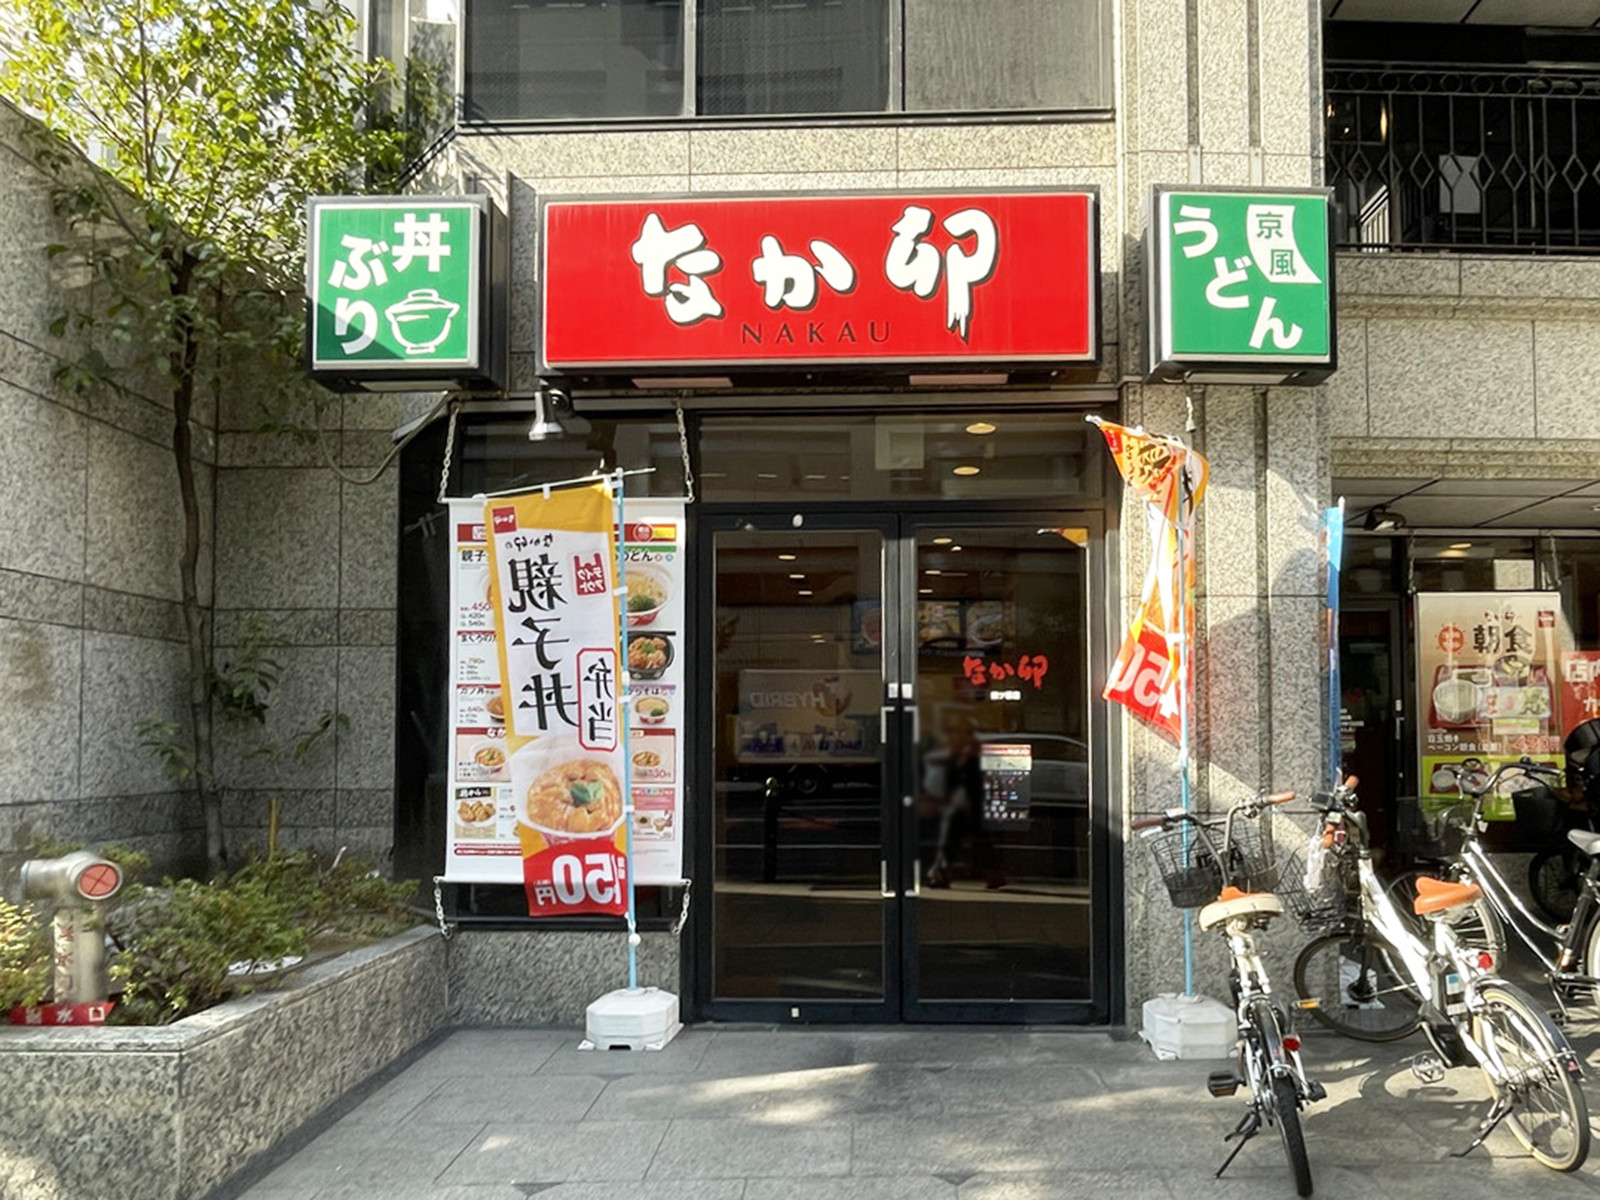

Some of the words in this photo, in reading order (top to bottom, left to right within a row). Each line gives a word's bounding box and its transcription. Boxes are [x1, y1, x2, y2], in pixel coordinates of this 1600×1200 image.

[1255, 211, 1298, 277] 京風
[631, 205, 999, 343] なか卯
[1173, 204, 1303, 350] うどん
[742, 322, 891, 345] NAKAU
[1473, 624, 1533, 655] 朝食
[962, 655, 1048, 690] なか卯
